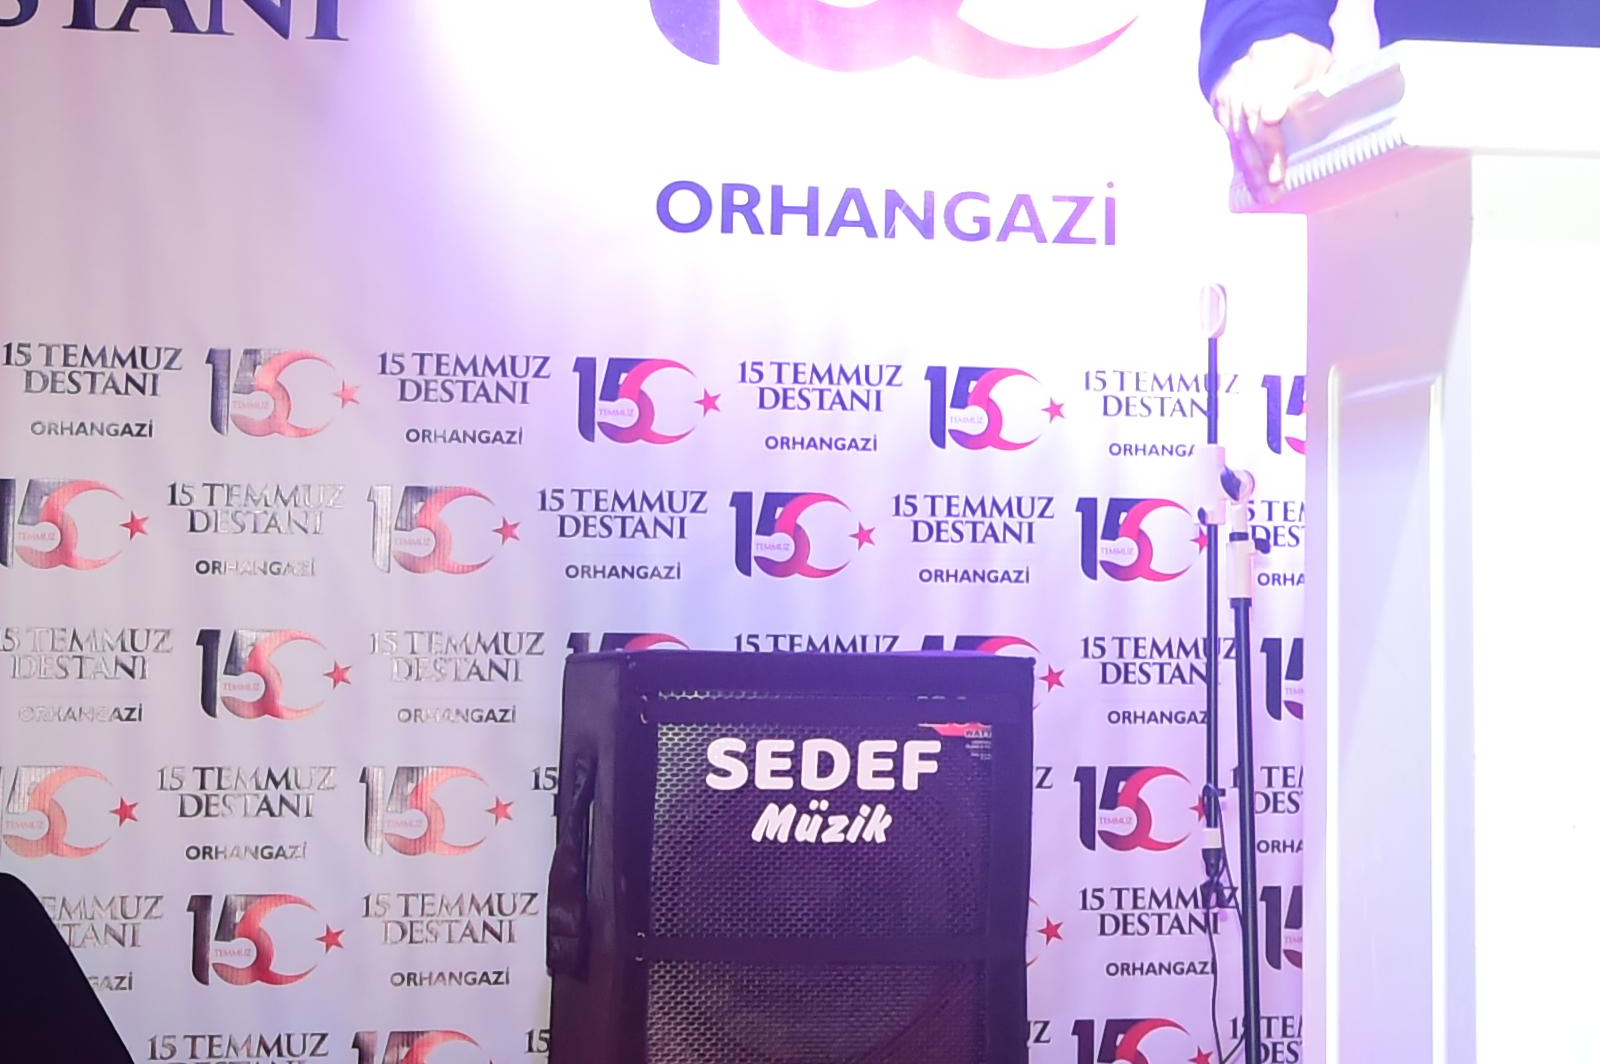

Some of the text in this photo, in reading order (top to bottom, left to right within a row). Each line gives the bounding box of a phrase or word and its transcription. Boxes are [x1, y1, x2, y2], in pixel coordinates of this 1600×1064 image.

[654, 178, 1117, 247] ORHANGAZİ
[2, 342, 182, 371] 15 TEMMUZ
[377, 352, 551, 379] 15 TEMMUZ
[24, 370, 160, 396] DESTANI
[738, 361, 902, 388] 15 TEMMUZ
[1084, 369, 1108, 391] 15
[398, 379, 530, 405] DESTANI
[571, 356, 654, 443] 15
[757, 387, 884, 412] DESTANI
[232, 400, 270, 410] TEMMUZ
[598, 408, 635, 417] TEMMUZ
[925, 365, 1003, 450] 15
[1102, 396, 1209, 418] DESTAN
[30, 419, 154, 438] ORHANGAZİ
[405, 427, 523, 446] ORHANGAZİ
[764, 433, 877, 452] ORHANGAZİ
[167, 482, 346, 508] 15 TEMMUZ
[537, 488, 708, 514] 15 TEMMUZ
[892, 494, 1054, 519] 15 TEMMUZ
[188, 508, 326, 536] DESTANI
[558, 513, 687, 539] DESTANI
[729, 491, 810, 577] 15
[910, 519, 1036, 544] DESTANI
[17, 532, 57, 540] TEMMUZ
[394, 537, 432, 546] TEMMUZ
[755, 543, 790, 551] TEMMUZ
[1075, 496, 1153, 581] 15
[1100, 547, 1135, 555] TEMMUZ
[195, 557, 316, 576] ORHANGAZİ
[565, 561, 681, 580] ORHANGAZİ
[918, 565, 1030, 584] ORHANGAZİ
[0, 625, 173, 653] 5 TEMMUZ
[370, 630, 397, 653] 15
[405, 630, 545, 655] TEMMUZ
[1080, 636, 1106, 659] 15
[10, 653, 148, 681] DESTANI
[196, 629, 284, 719] 15
[391, 656, 524, 682] DESTANI
[1099, 660, 1220, 685] DESTAN
[223, 682, 261, 691] TEMMUZ
[18, 703, 142, 722] ORHANGAZİ
[397, 704, 517, 724] ORHANGAZİ
[1107, 709, 1208, 725] ORHANGAZ
[705, 737, 941, 792] SEDEF
[157, 766, 336, 792] 15 TEMMUZ
[0, 765, 67, 856] 5
[178, 792, 314, 819] DESTANI
[359, 765, 446, 855] 15
[1074, 766, 1152, 852] 15
[4, 820, 45, 828] TEMMUZ
[386, 819, 424, 827] TEMMUZ
[751, 800, 892, 844] Müzik
[186, 842, 307, 861] ORHANGAZİ
[361, 893, 539, 918] 15 TEMMUZ
[1079, 888, 1105, 911] 15
[382, 918, 517, 944] DESTANI
[1098, 912, 1221, 936] DESTANI
[187, 894, 272, 984] 15
[214, 948, 252, 957] TEMMUZ
[390, 969, 510, 988] ORHANGAZİ
[148, 1035, 176, 1060] 15
[183, 1032, 328, 1059] TEMMUZ
